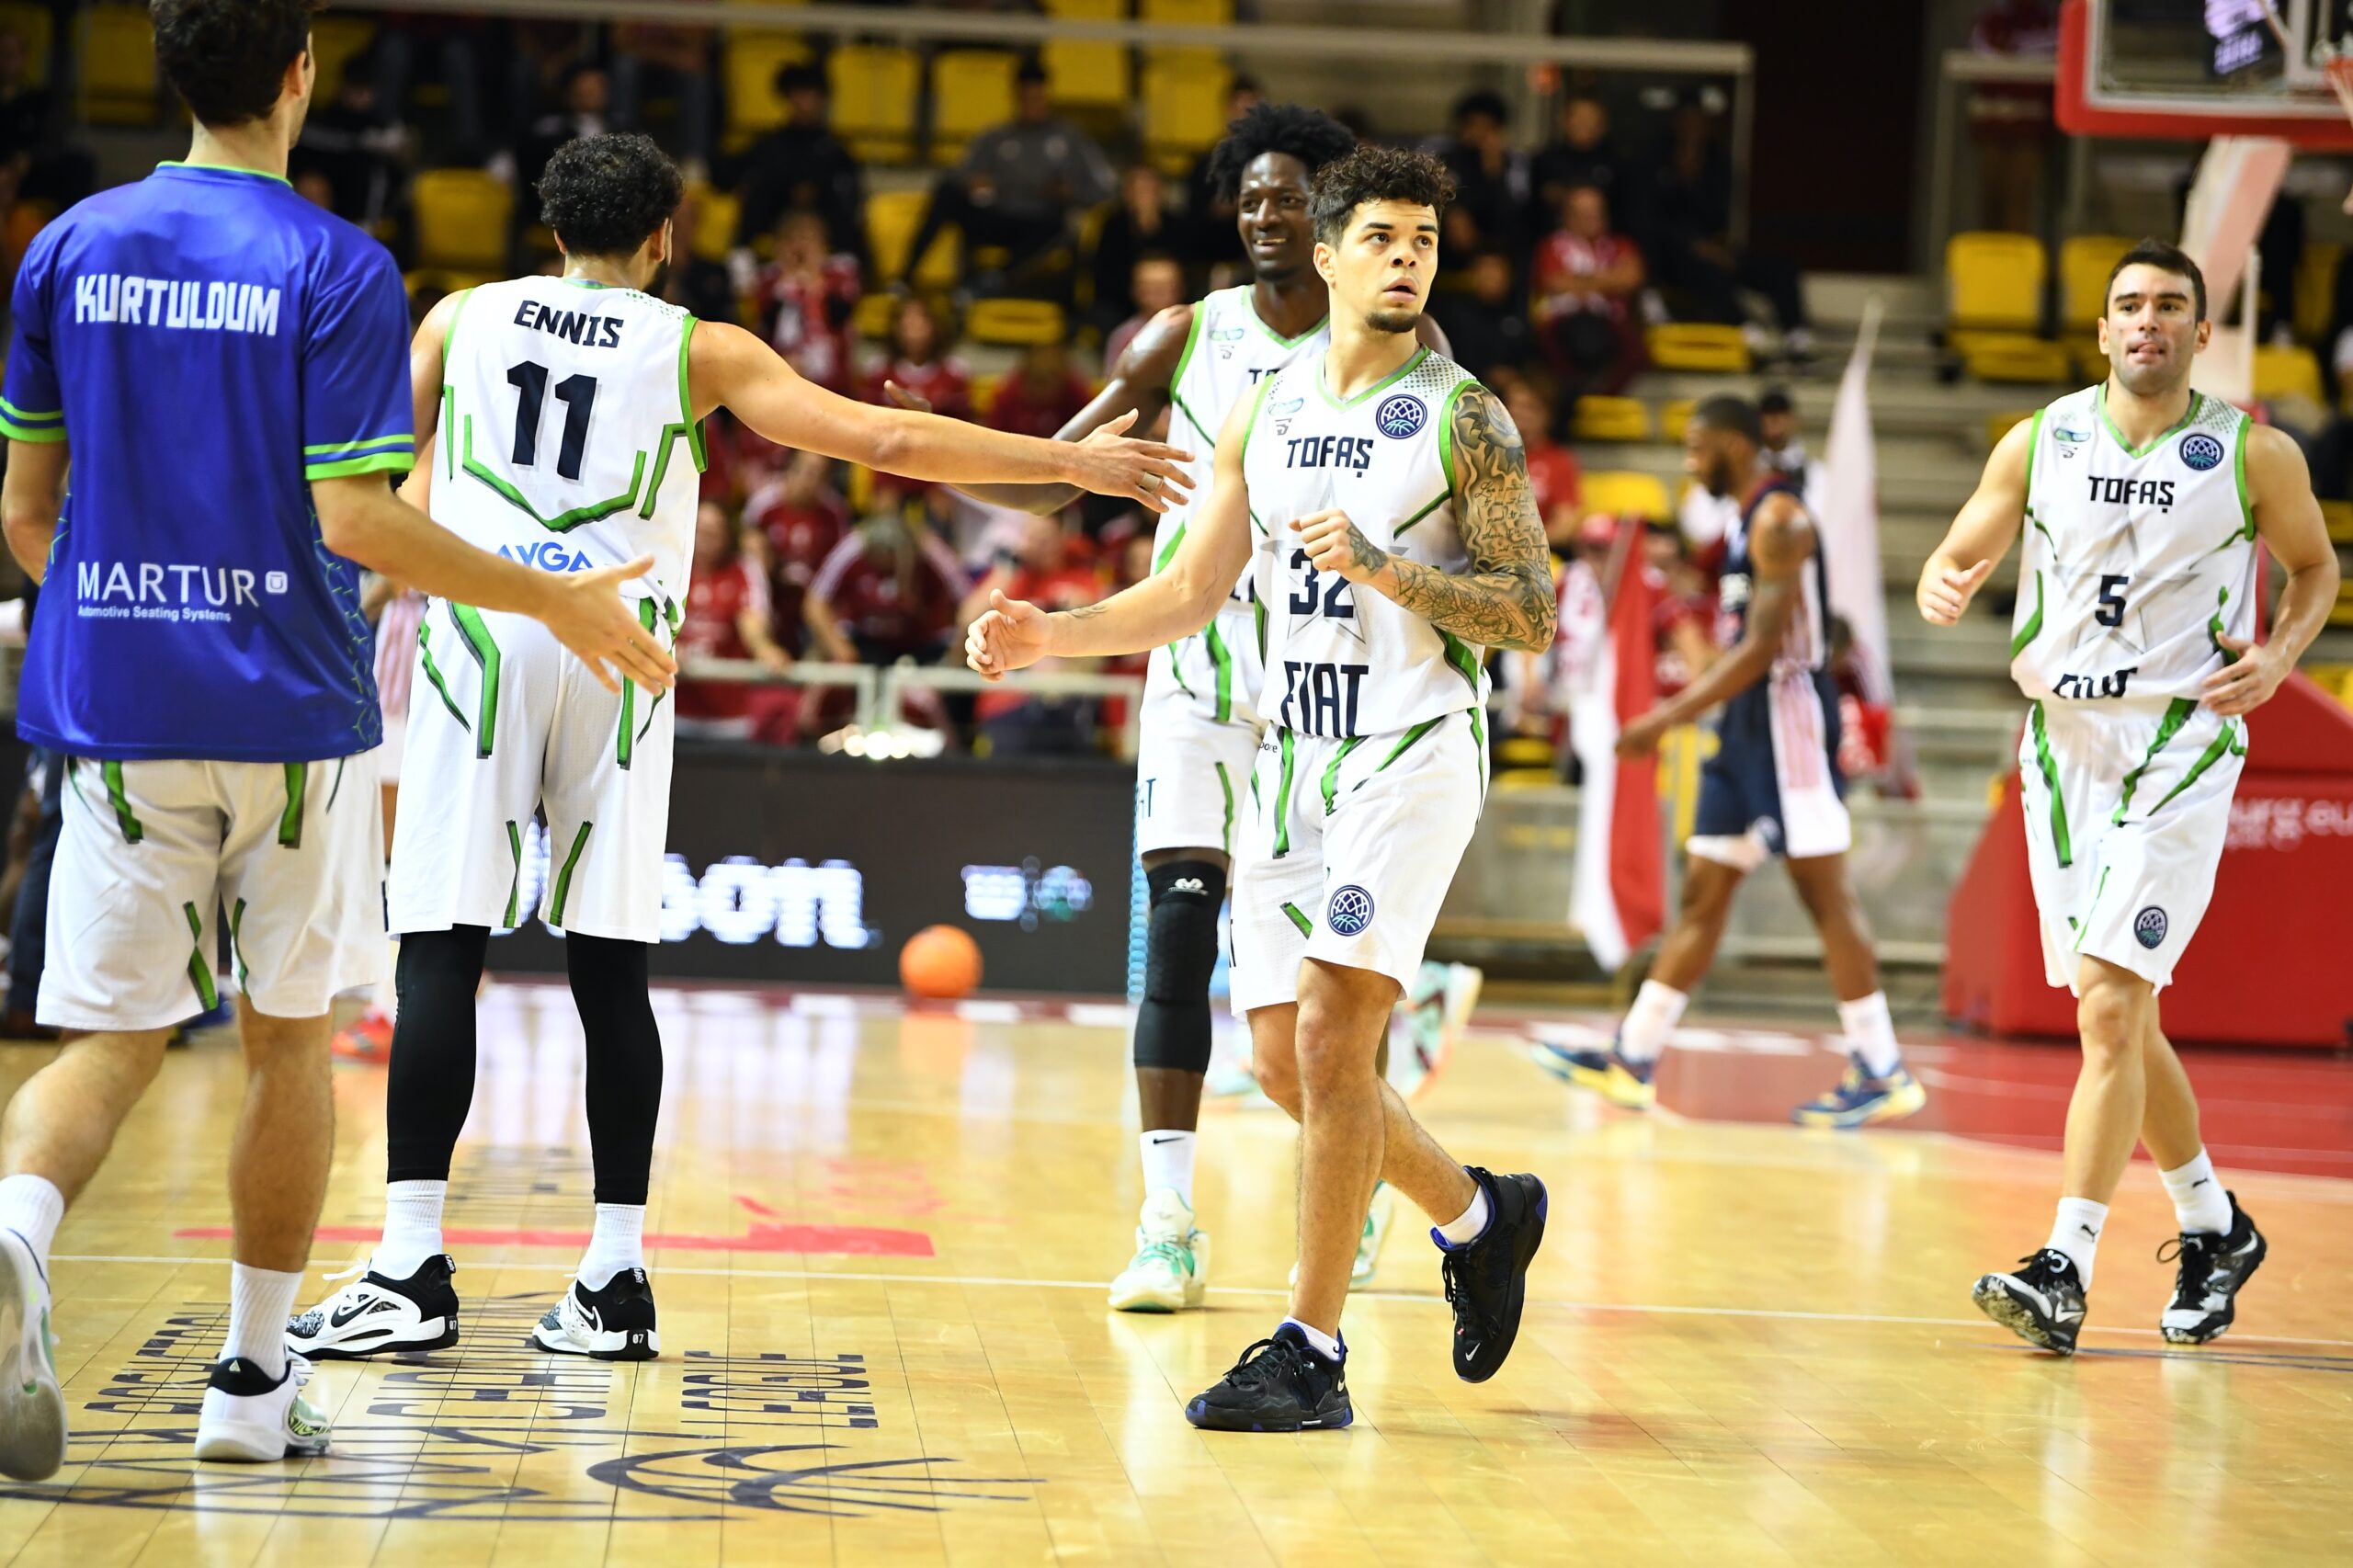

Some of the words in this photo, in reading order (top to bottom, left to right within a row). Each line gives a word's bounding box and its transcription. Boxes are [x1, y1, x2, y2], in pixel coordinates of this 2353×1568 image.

[75, 274, 281, 336] KURTULDUM
[513, 300, 624, 348] ENNIS
[506, 359, 599, 481] 11
[1287, 435, 1374, 478] TOFAŞ
[2087, 474, 2176, 514] TOFAŞ
[77, 561, 259, 608] MARTUR
[1289, 548, 1354, 618] 32
[2094, 574, 2130, 627] 5
[78, 605, 131, 619] Automotive
[132, 606, 180, 622] Seating
[182, 607, 232, 622] Systems
[1280, 660, 1370, 739] FIAT
[631, 1333, 644, 1345] 07
[680, 1349, 880, 1428] LEAGUE
